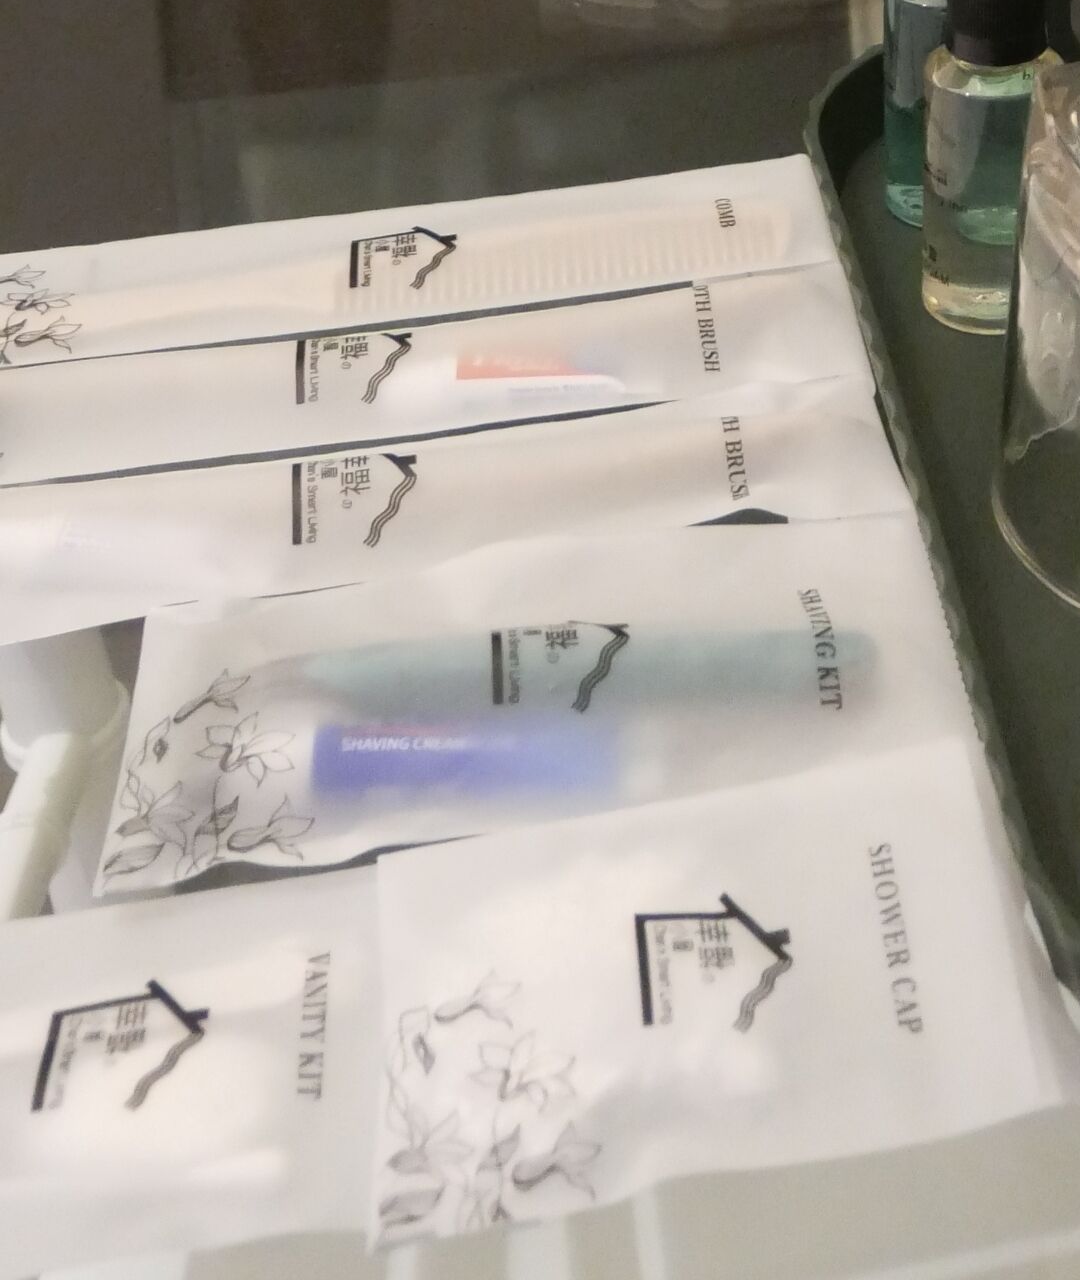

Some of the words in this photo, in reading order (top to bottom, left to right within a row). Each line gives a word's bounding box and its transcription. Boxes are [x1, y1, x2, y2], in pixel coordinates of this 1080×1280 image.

[715, 198, 736, 228] COMB
[698, 318, 720, 372] BRUSH
[307, 485, 318, 514] Smart
[305, 516, 319, 544] Living
[816, 666, 843, 711] KIT
[341, 737, 410, 751] SHAVING
[868, 842, 911, 968] SHOWER
[891, 977, 924, 1034] CAP
[301, 950, 331, 1043] VANITY
[297, 1051, 324, 1100] KIT
